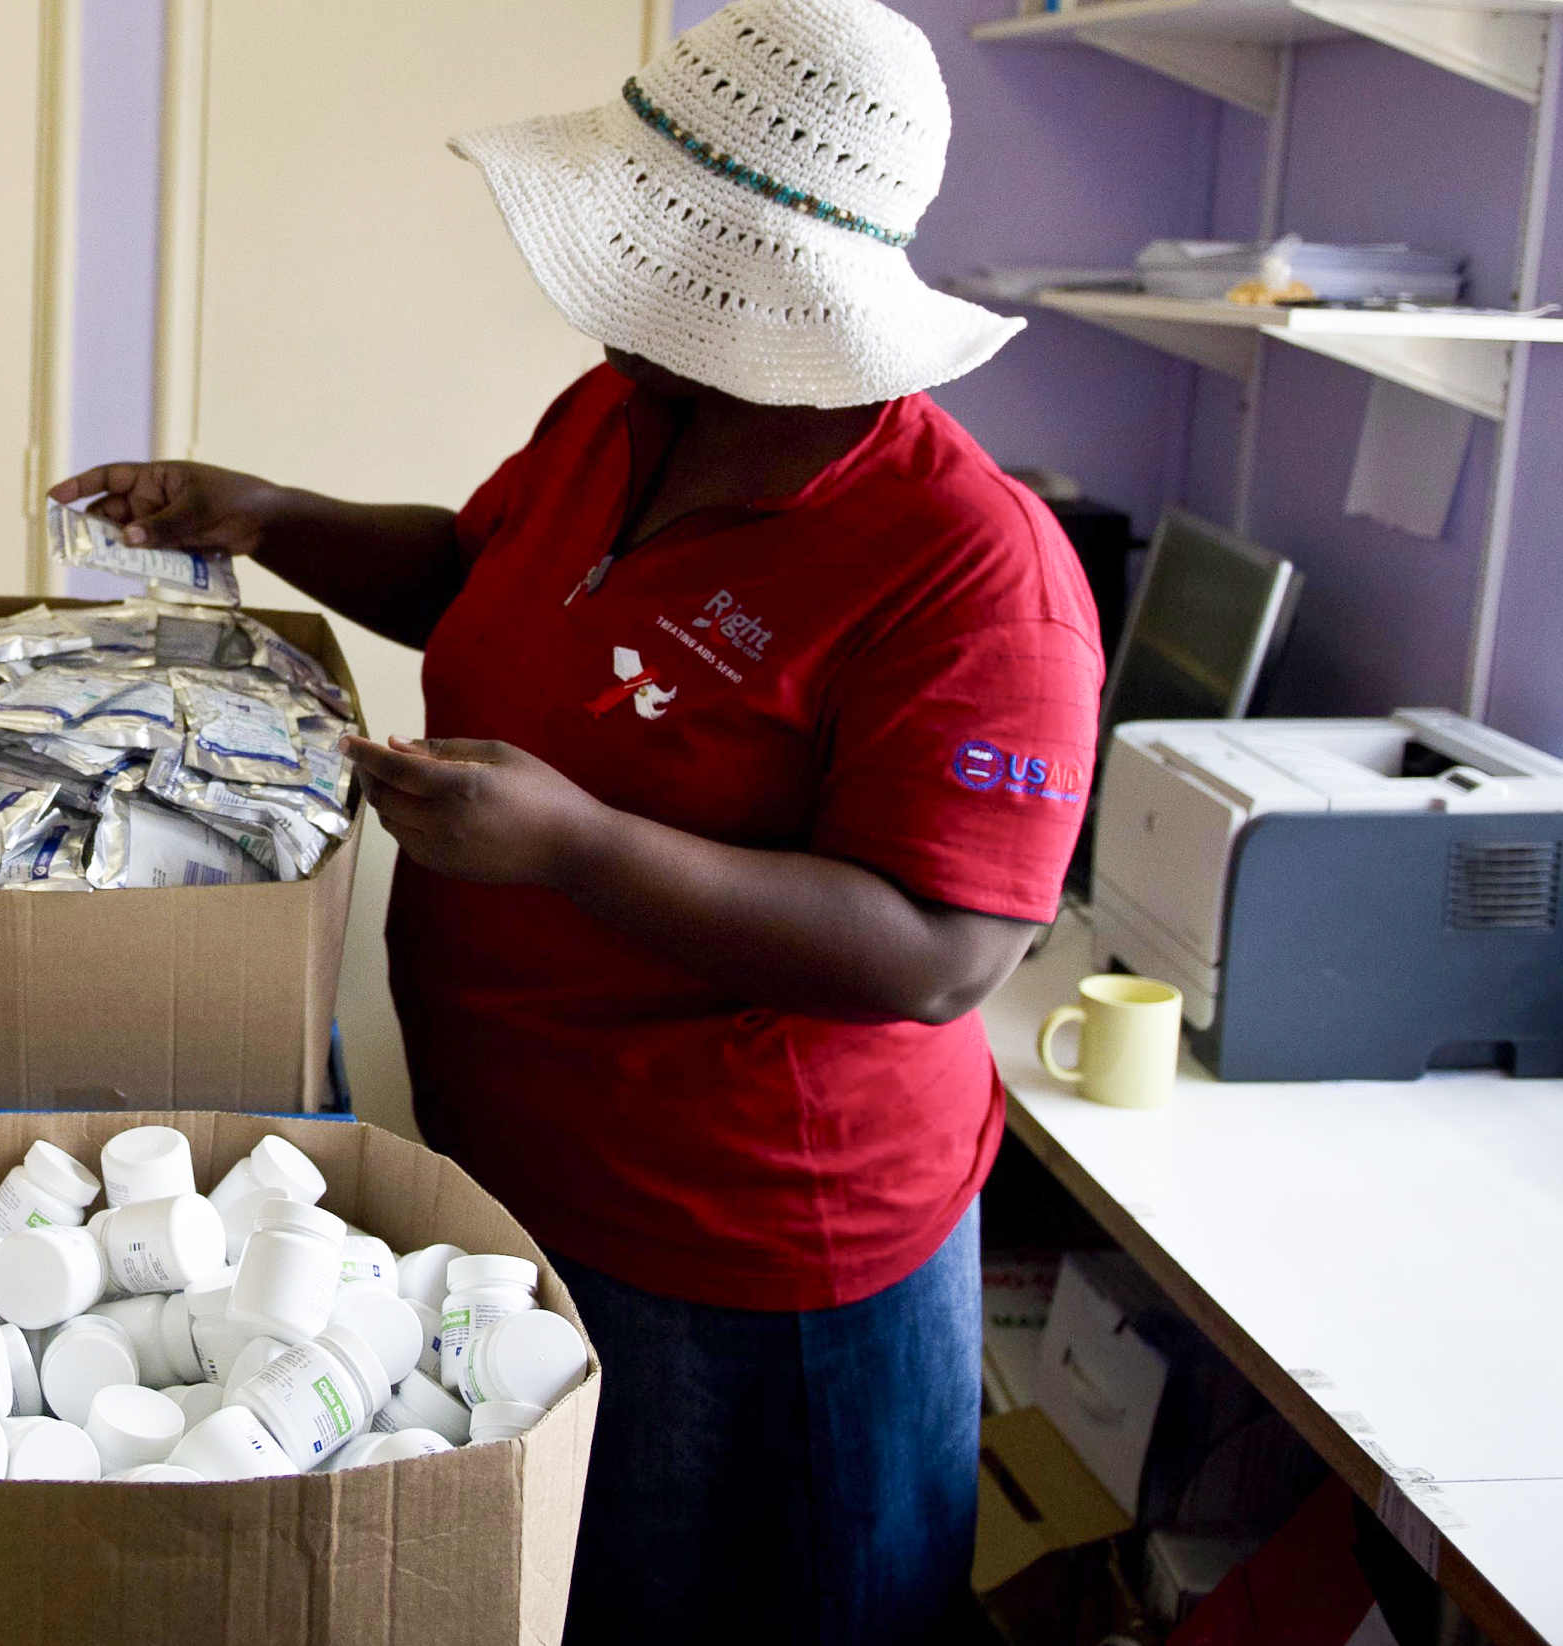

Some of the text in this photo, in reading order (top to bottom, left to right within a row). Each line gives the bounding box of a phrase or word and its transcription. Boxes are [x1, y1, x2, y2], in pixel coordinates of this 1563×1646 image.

[656, 615, 697, 648] TREATING
[694, 644, 717, 664] AIDS
[1009, 754, 1083, 792] USAID
[318, 1380, 335, 1406] Cipla
[333, 1404, 348, 1433] Duovir
